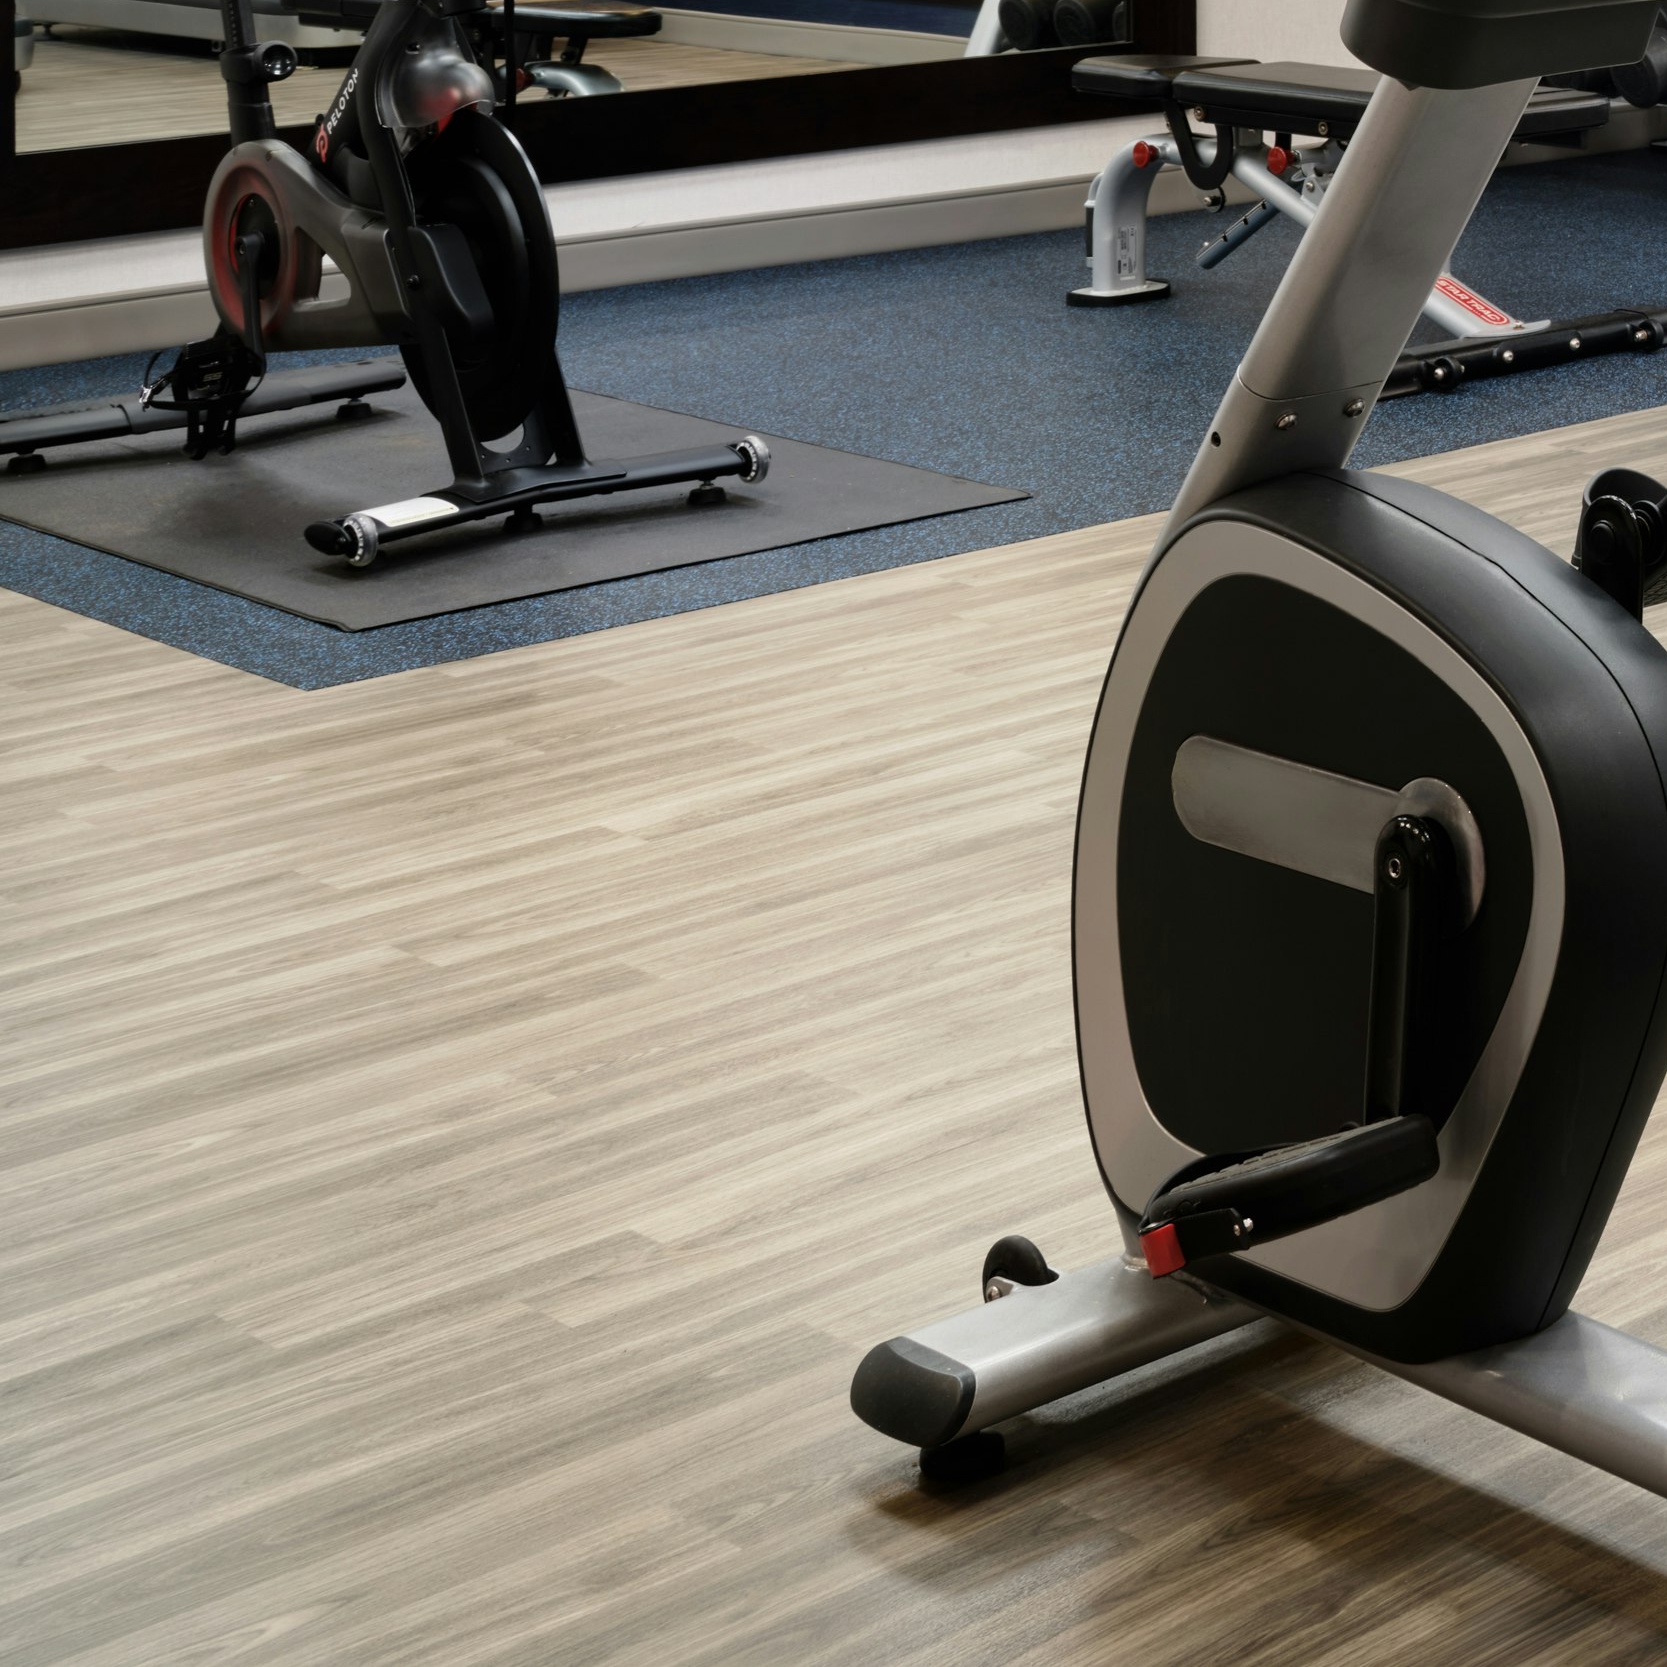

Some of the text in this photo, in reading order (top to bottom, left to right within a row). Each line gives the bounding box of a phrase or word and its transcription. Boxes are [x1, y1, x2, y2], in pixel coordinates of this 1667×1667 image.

[327, 68, 359, 135] PELOTON
[1439, 280, 1501, 321] STAR TRAC
